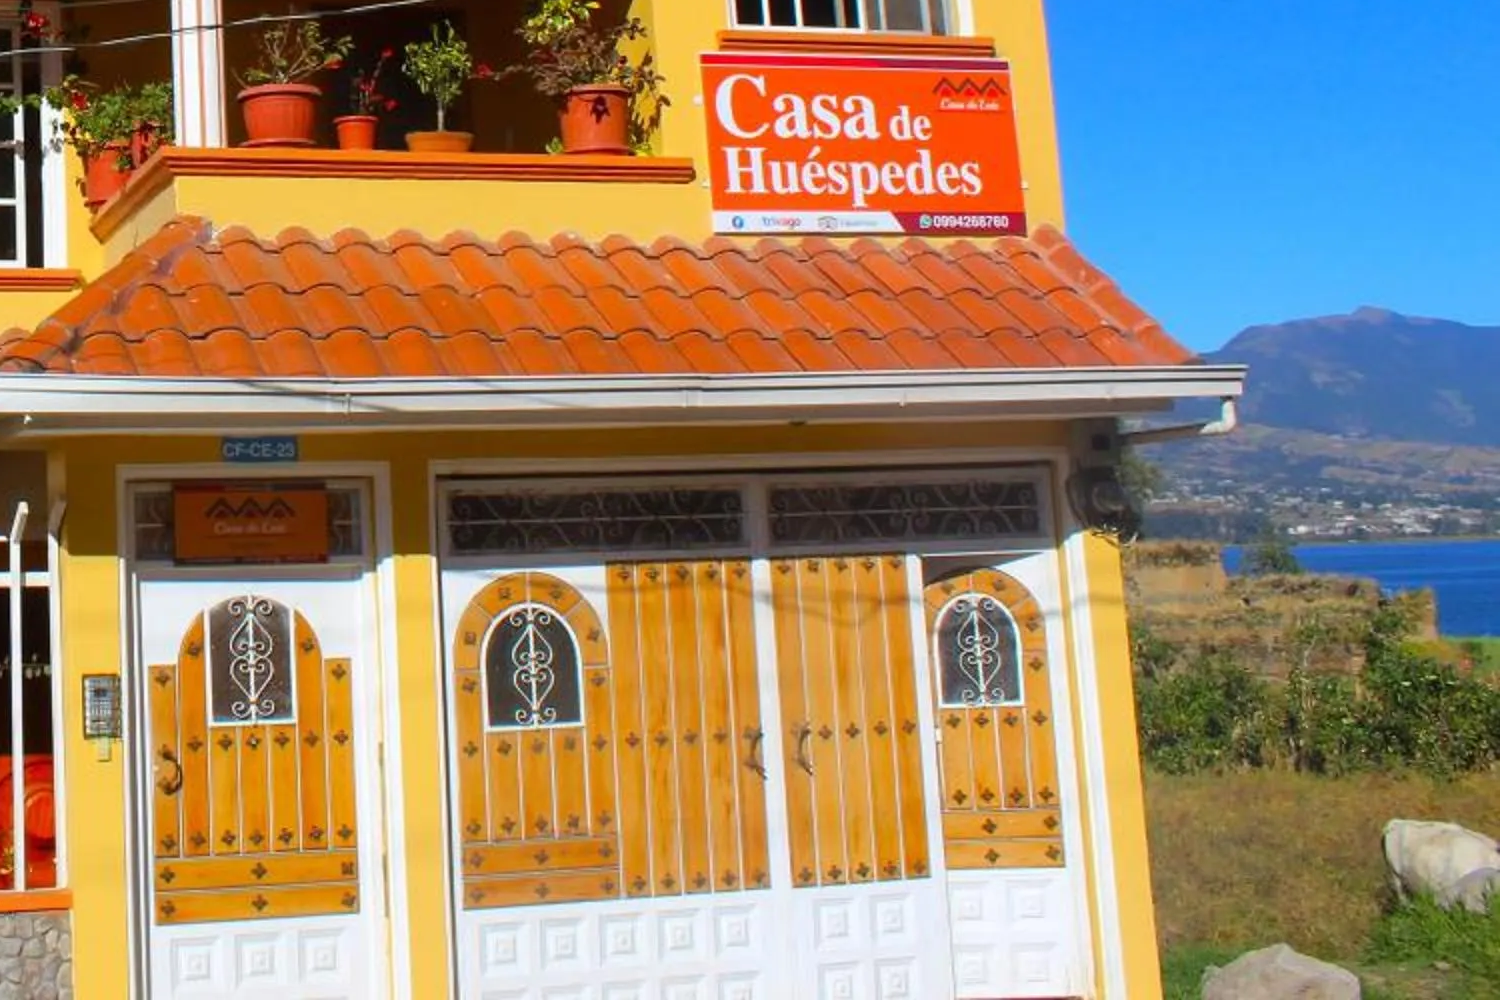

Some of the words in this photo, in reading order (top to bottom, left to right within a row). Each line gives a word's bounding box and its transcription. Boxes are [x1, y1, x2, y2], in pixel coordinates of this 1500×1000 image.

[714, 73, 880, 139] Casa
[889, 105, 933, 141] de
[721, 145, 983, 208] Huéspedes
